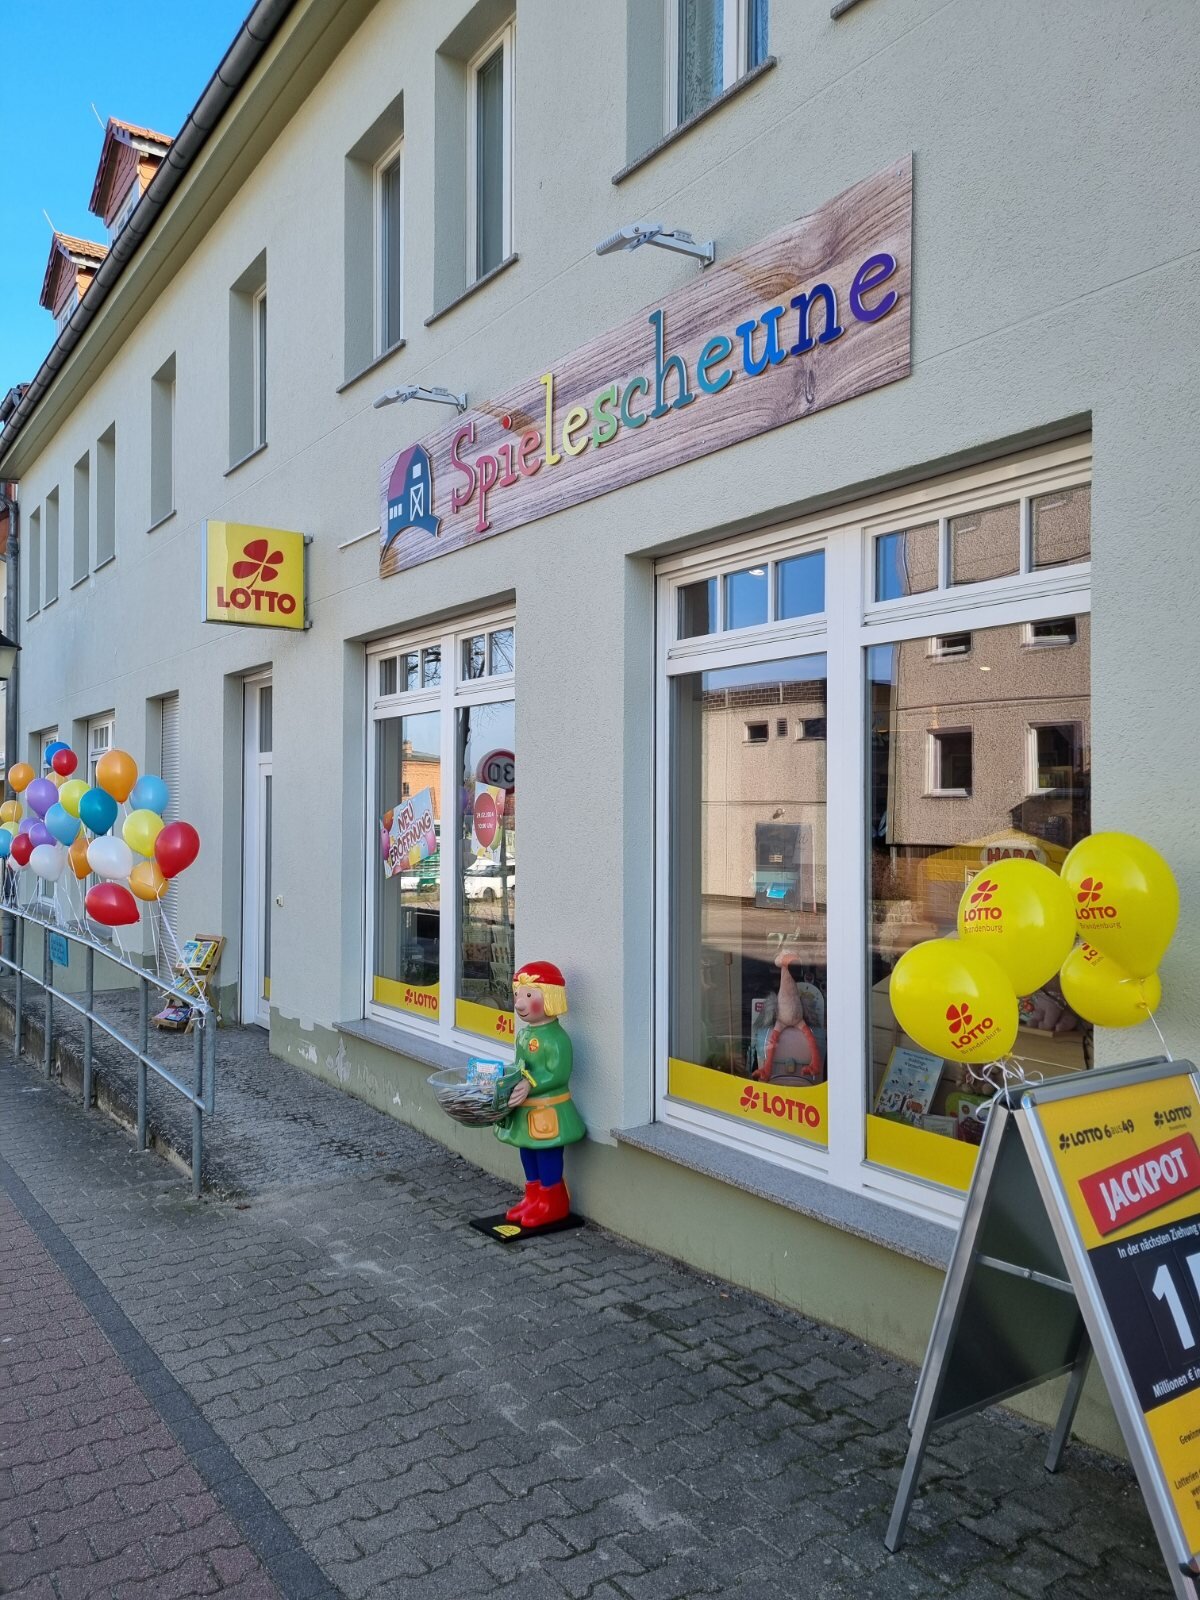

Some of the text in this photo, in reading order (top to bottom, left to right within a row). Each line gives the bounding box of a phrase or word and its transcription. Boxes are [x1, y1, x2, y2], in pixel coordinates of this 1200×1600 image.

[450, 251, 899, 533] Spielescheune
[216, 586, 297, 615] LOTTO
[397, 800, 415, 833] NEU
[963, 907, 1002, 922] LOTTO
[1075, 906, 1117, 920] LOTTO
[413, 991, 438, 1010] LOTTO
[950, 1017, 993, 1050] LOTTO
[762, 1092, 821, 1128] LOTTO
[1163, 1105, 1192, 1123] LOTTO
[1070, 1126, 1103, 1146] LOTTO
[1099, 1147, 1189, 1222] JACKPOT
[1117, 1224, 1200, 1259] In der nächsten Ziehung
[1152, 1374, 1188, 1398] Millionen
[1187, 1368, 1195, 1382] €
